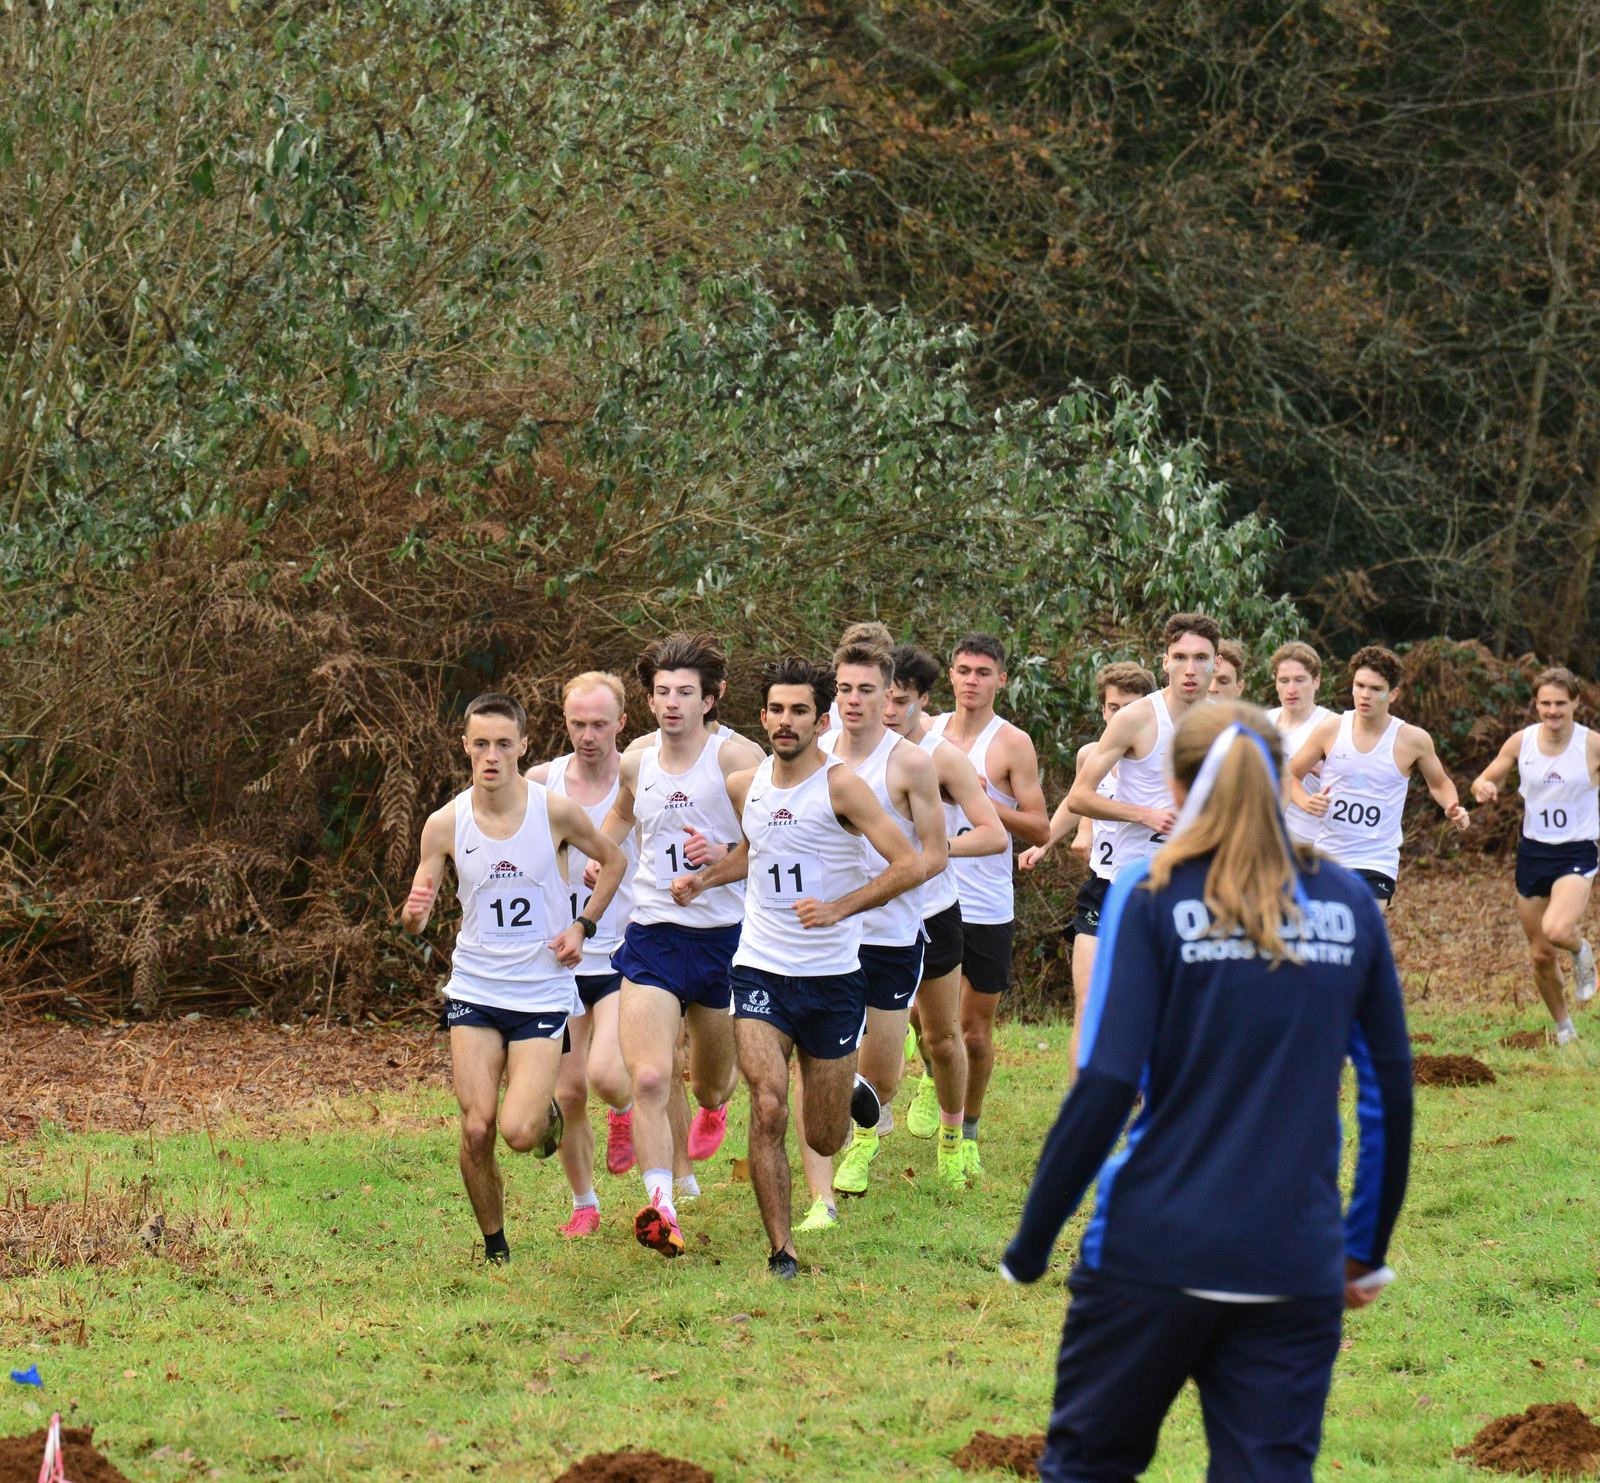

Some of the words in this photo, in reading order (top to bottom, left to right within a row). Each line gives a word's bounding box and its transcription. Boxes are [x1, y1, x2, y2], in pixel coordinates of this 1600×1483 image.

[1332, 799, 1381, 827] 209
[1539, 808, 1567, 828] 10
[768, 863, 803, 892] 11
[489, 897, 533, 927] 12
